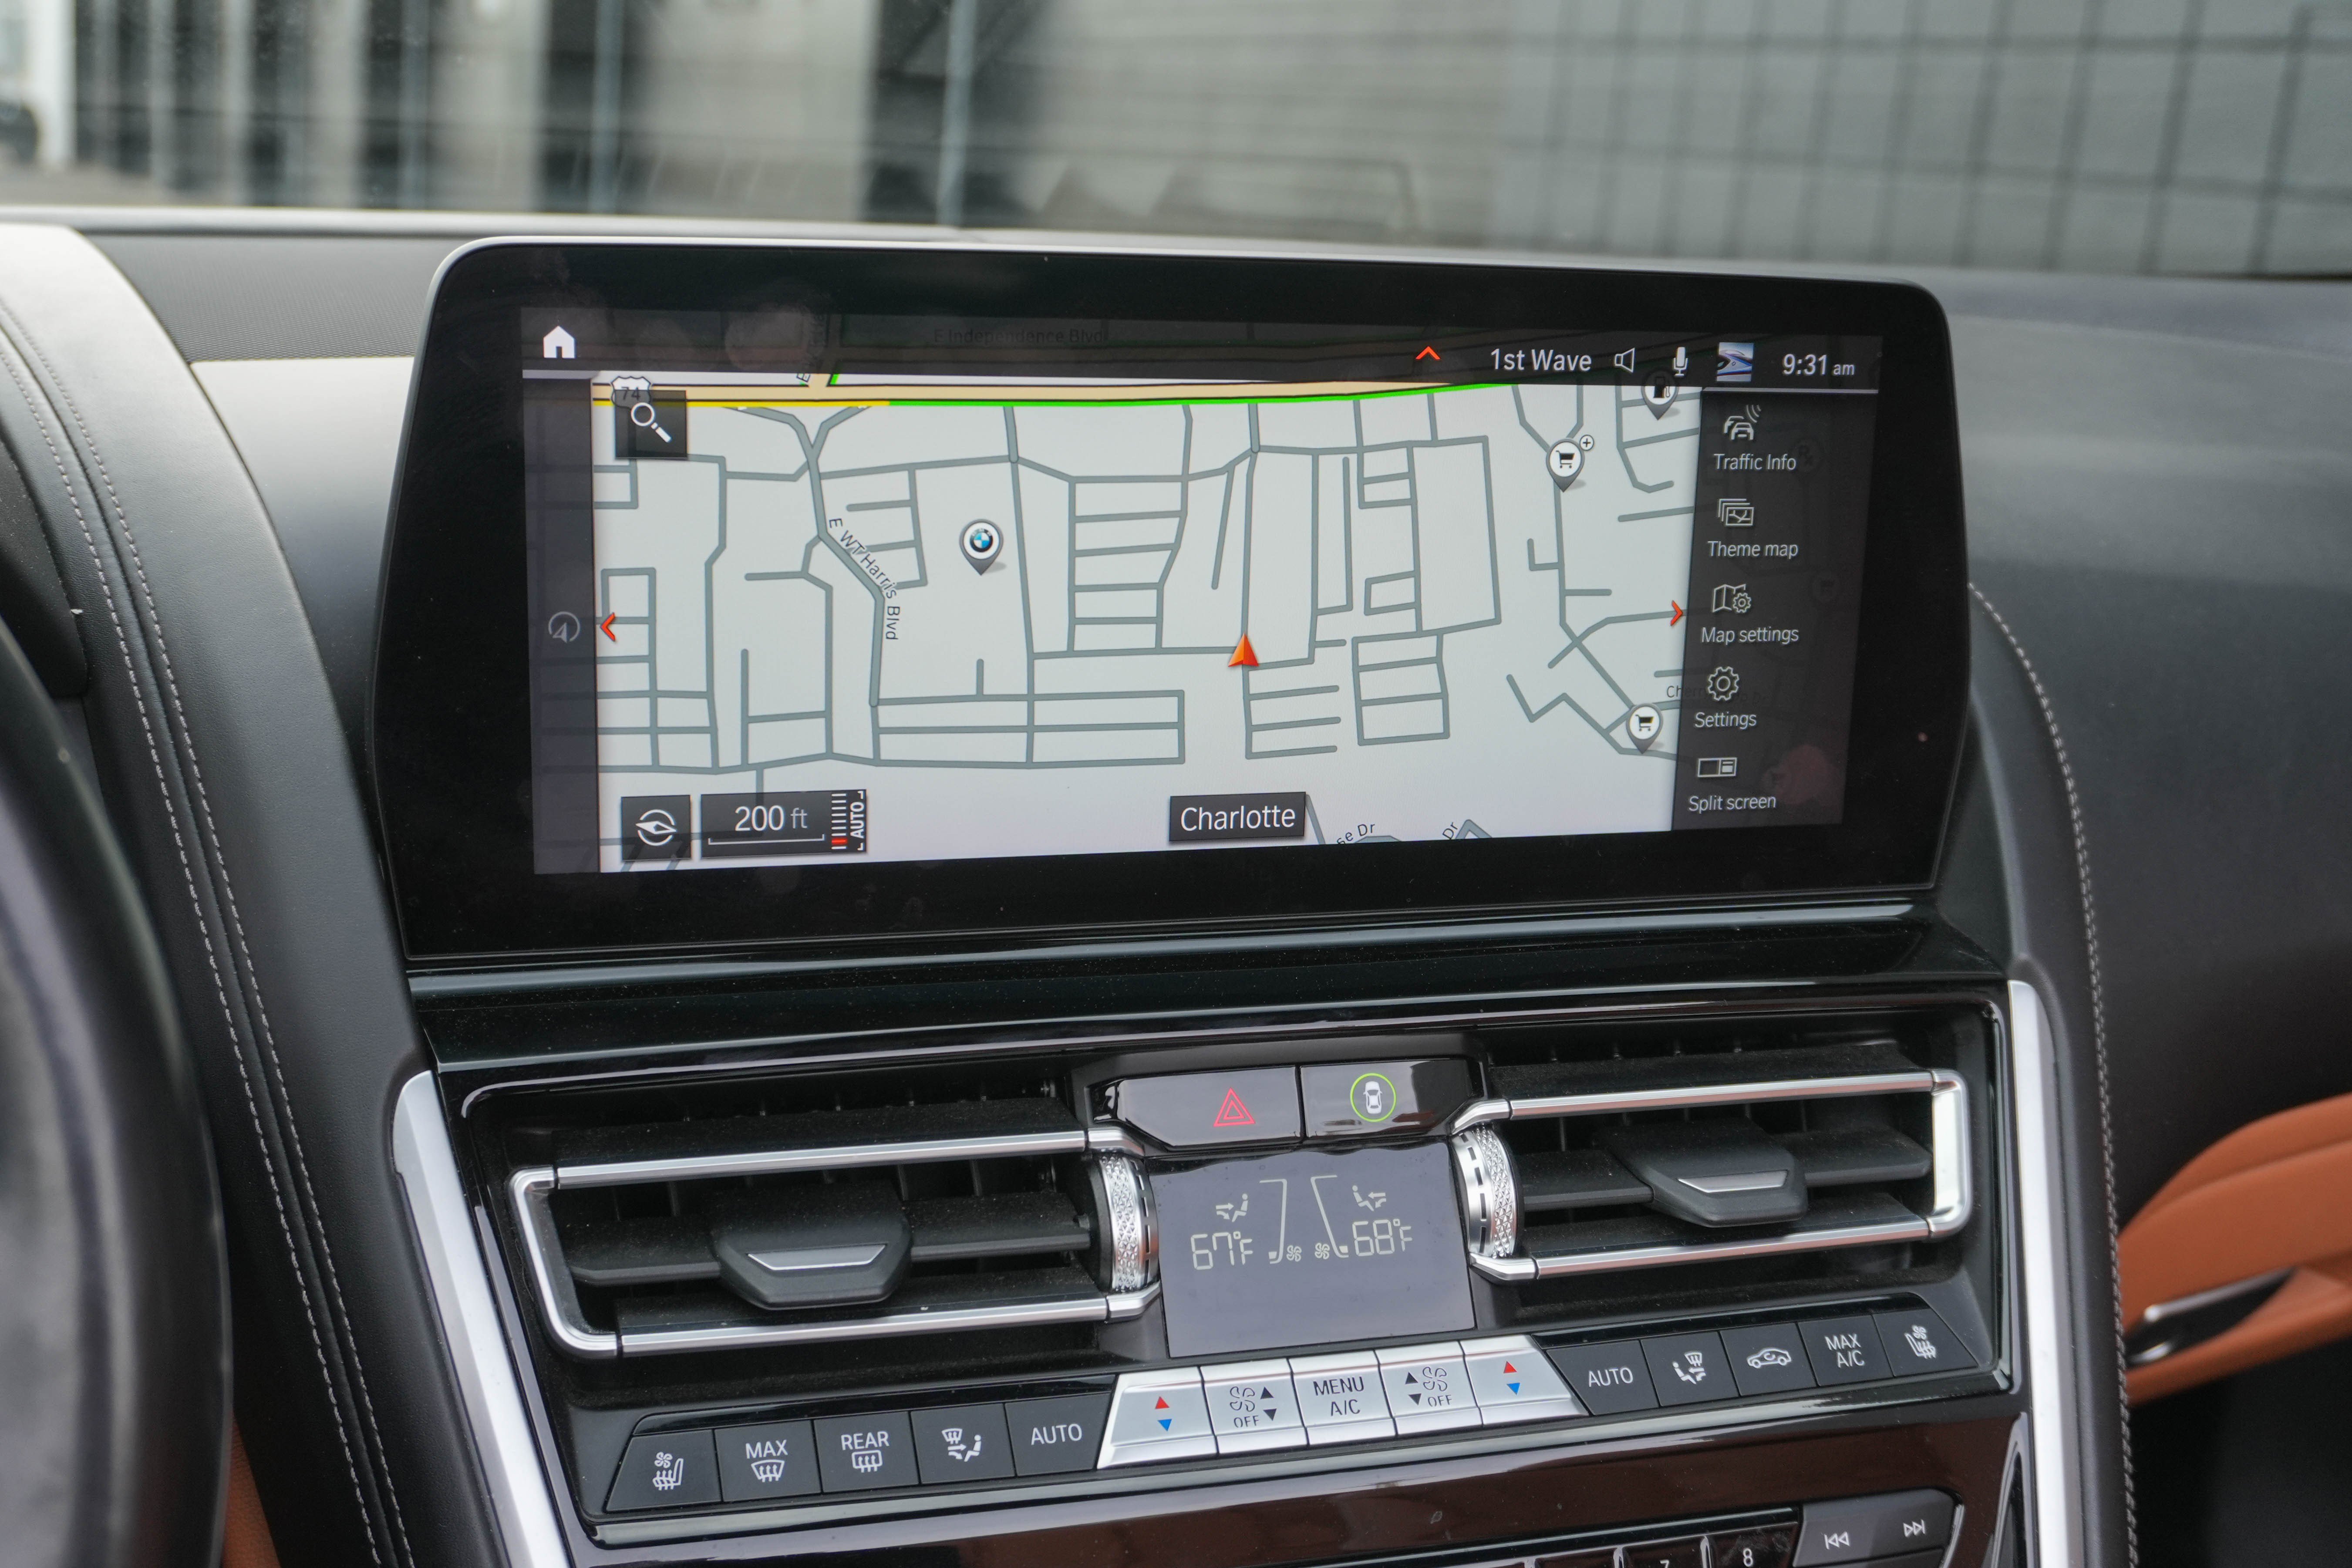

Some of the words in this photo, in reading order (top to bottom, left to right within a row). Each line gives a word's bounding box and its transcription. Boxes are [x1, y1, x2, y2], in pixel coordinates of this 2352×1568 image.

[1491, 348, 1525, 371] 1st
[1531, 349, 1591, 371] Wave
[1783, 354, 1827, 375] 9:31
[1833, 364, 1855, 375] am
[621, 386, 641, 401] 74
[1714, 453, 1762, 470] Traffic
[1768, 453, 1796, 470] Info
[1708, 540, 1761, 557] Theme
[1765, 542, 1799, 559] map
[829, 518, 843, 528] E
[860, 553, 897, 599] Harris
[885, 606, 900, 640] Blvd
[1702, 627, 1735, 645] Map
[1739, 627, 1799, 645] settings
[1695, 712, 1757, 730] Settings
[1688, 795, 1723, 814] Split
[1726, 796, 1776, 810] screen
[735, 805, 784, 831] 200
[790, 807, 808, 829] ft
[850, 802, 864, 839] AUTO
[1181, 805, 1295, 831] Charlotte
[1358, 823, 1375, 836] Dr
[1442, 822, 1458, 840] Dr
[1825, 1334, 1861, 1351] MAX
[1836, 1350, 1865, 1368] A/C
[1314, 1376, 1364, 1396] MENU
[1588, 1367, 1634, 1387] AUTO
[1331, 1399, 1361, 1416] A/C
[1428, 1394, 1452, 1407] OFF
[1233, 1415, 1259, 1428] OFF
[841, 1431, 890, 1449] REAR
[1031, 1423, 1083, 1445] AUTO
[745, 1440, 788, 1459] MAX
[1743, 1548, 1753, 1567] 8
